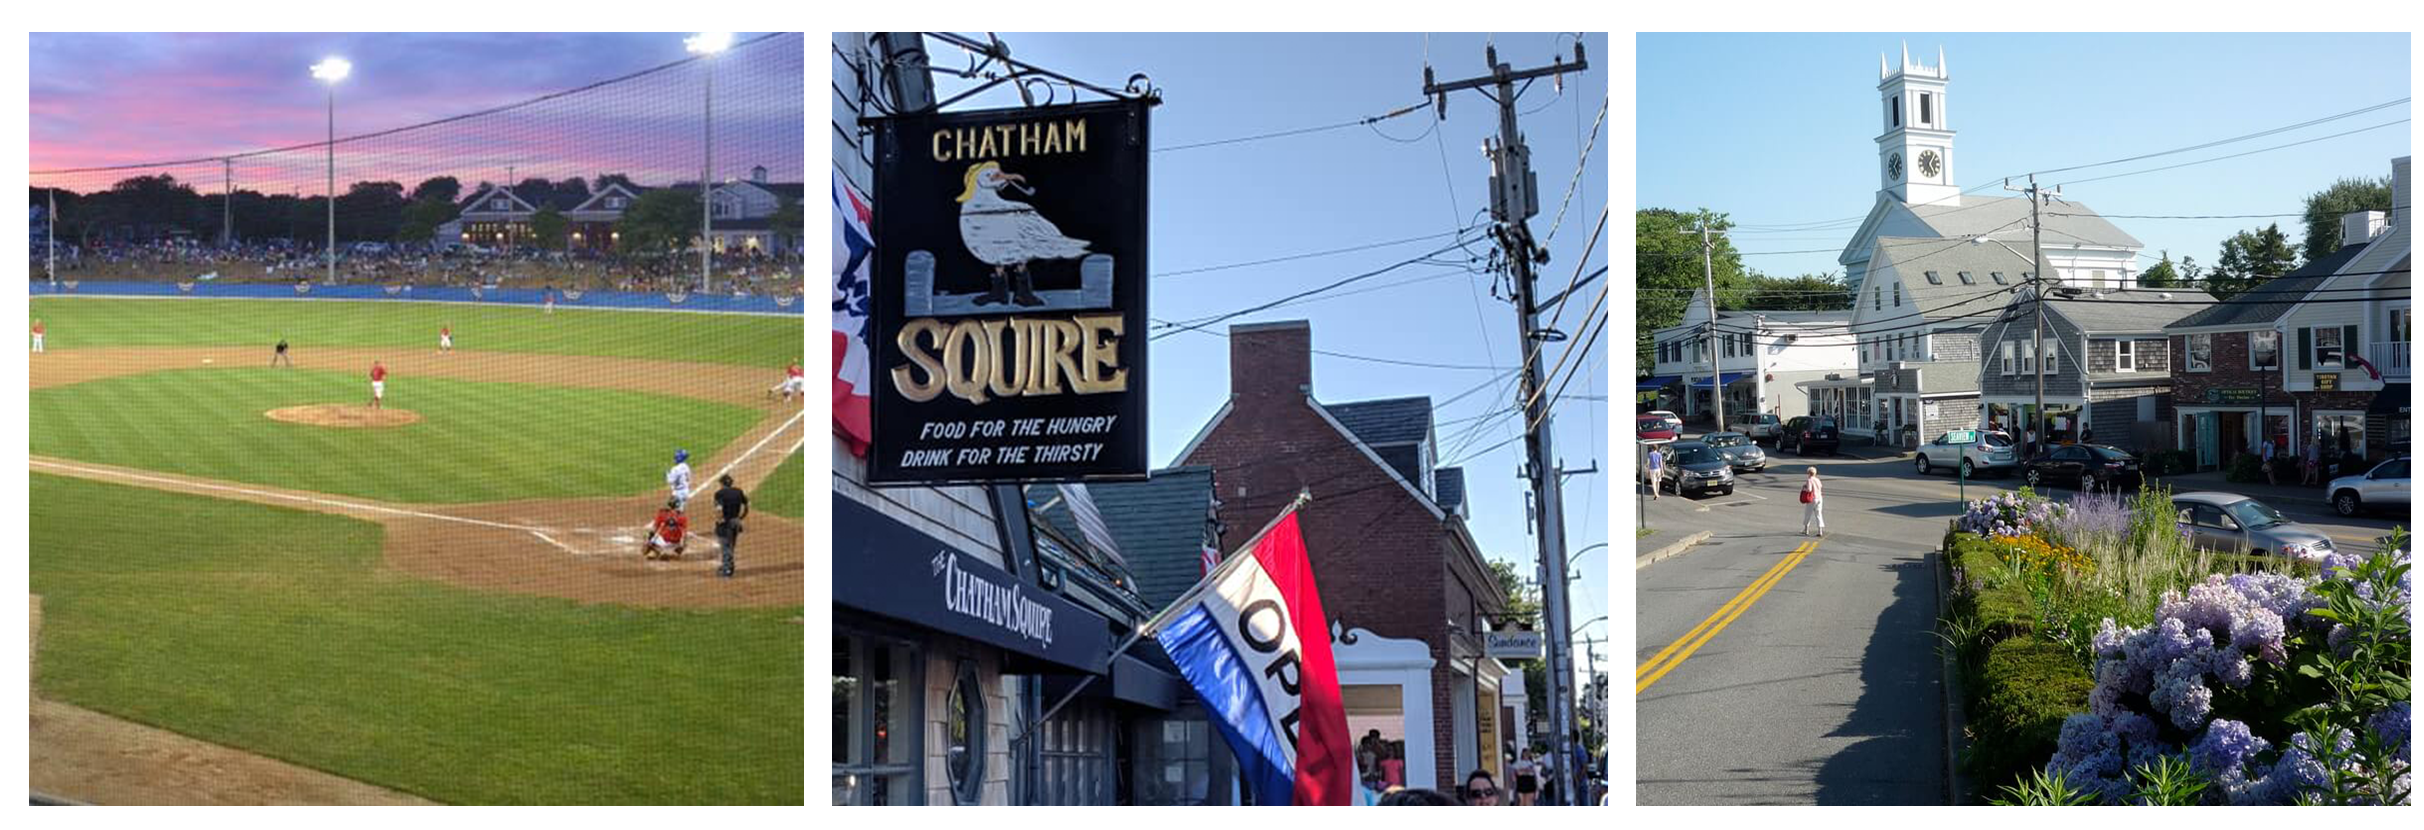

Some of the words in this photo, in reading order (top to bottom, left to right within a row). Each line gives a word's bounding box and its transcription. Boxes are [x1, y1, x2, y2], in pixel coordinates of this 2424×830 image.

[932, 117, 1088, 162] CHATHAM
[891, 314, 1129, 405] SQUIRE
[920, 420, 967, 440] FOOD
[969, 418, 1006, 439] FOR
[1011, 418, 1046, 436] THE
[1046, 415, 1118, 436] HUNGRY
[900, 449, 953, 467] DRINK
[956, 447, 992, 466] FOR
[996, 446, 1030, 464] THE
[1033, 443, 1104, 464] THIRSTY
[931, 550, 946, 577] THE
[1488, 635, 1537, 648] Sundance
